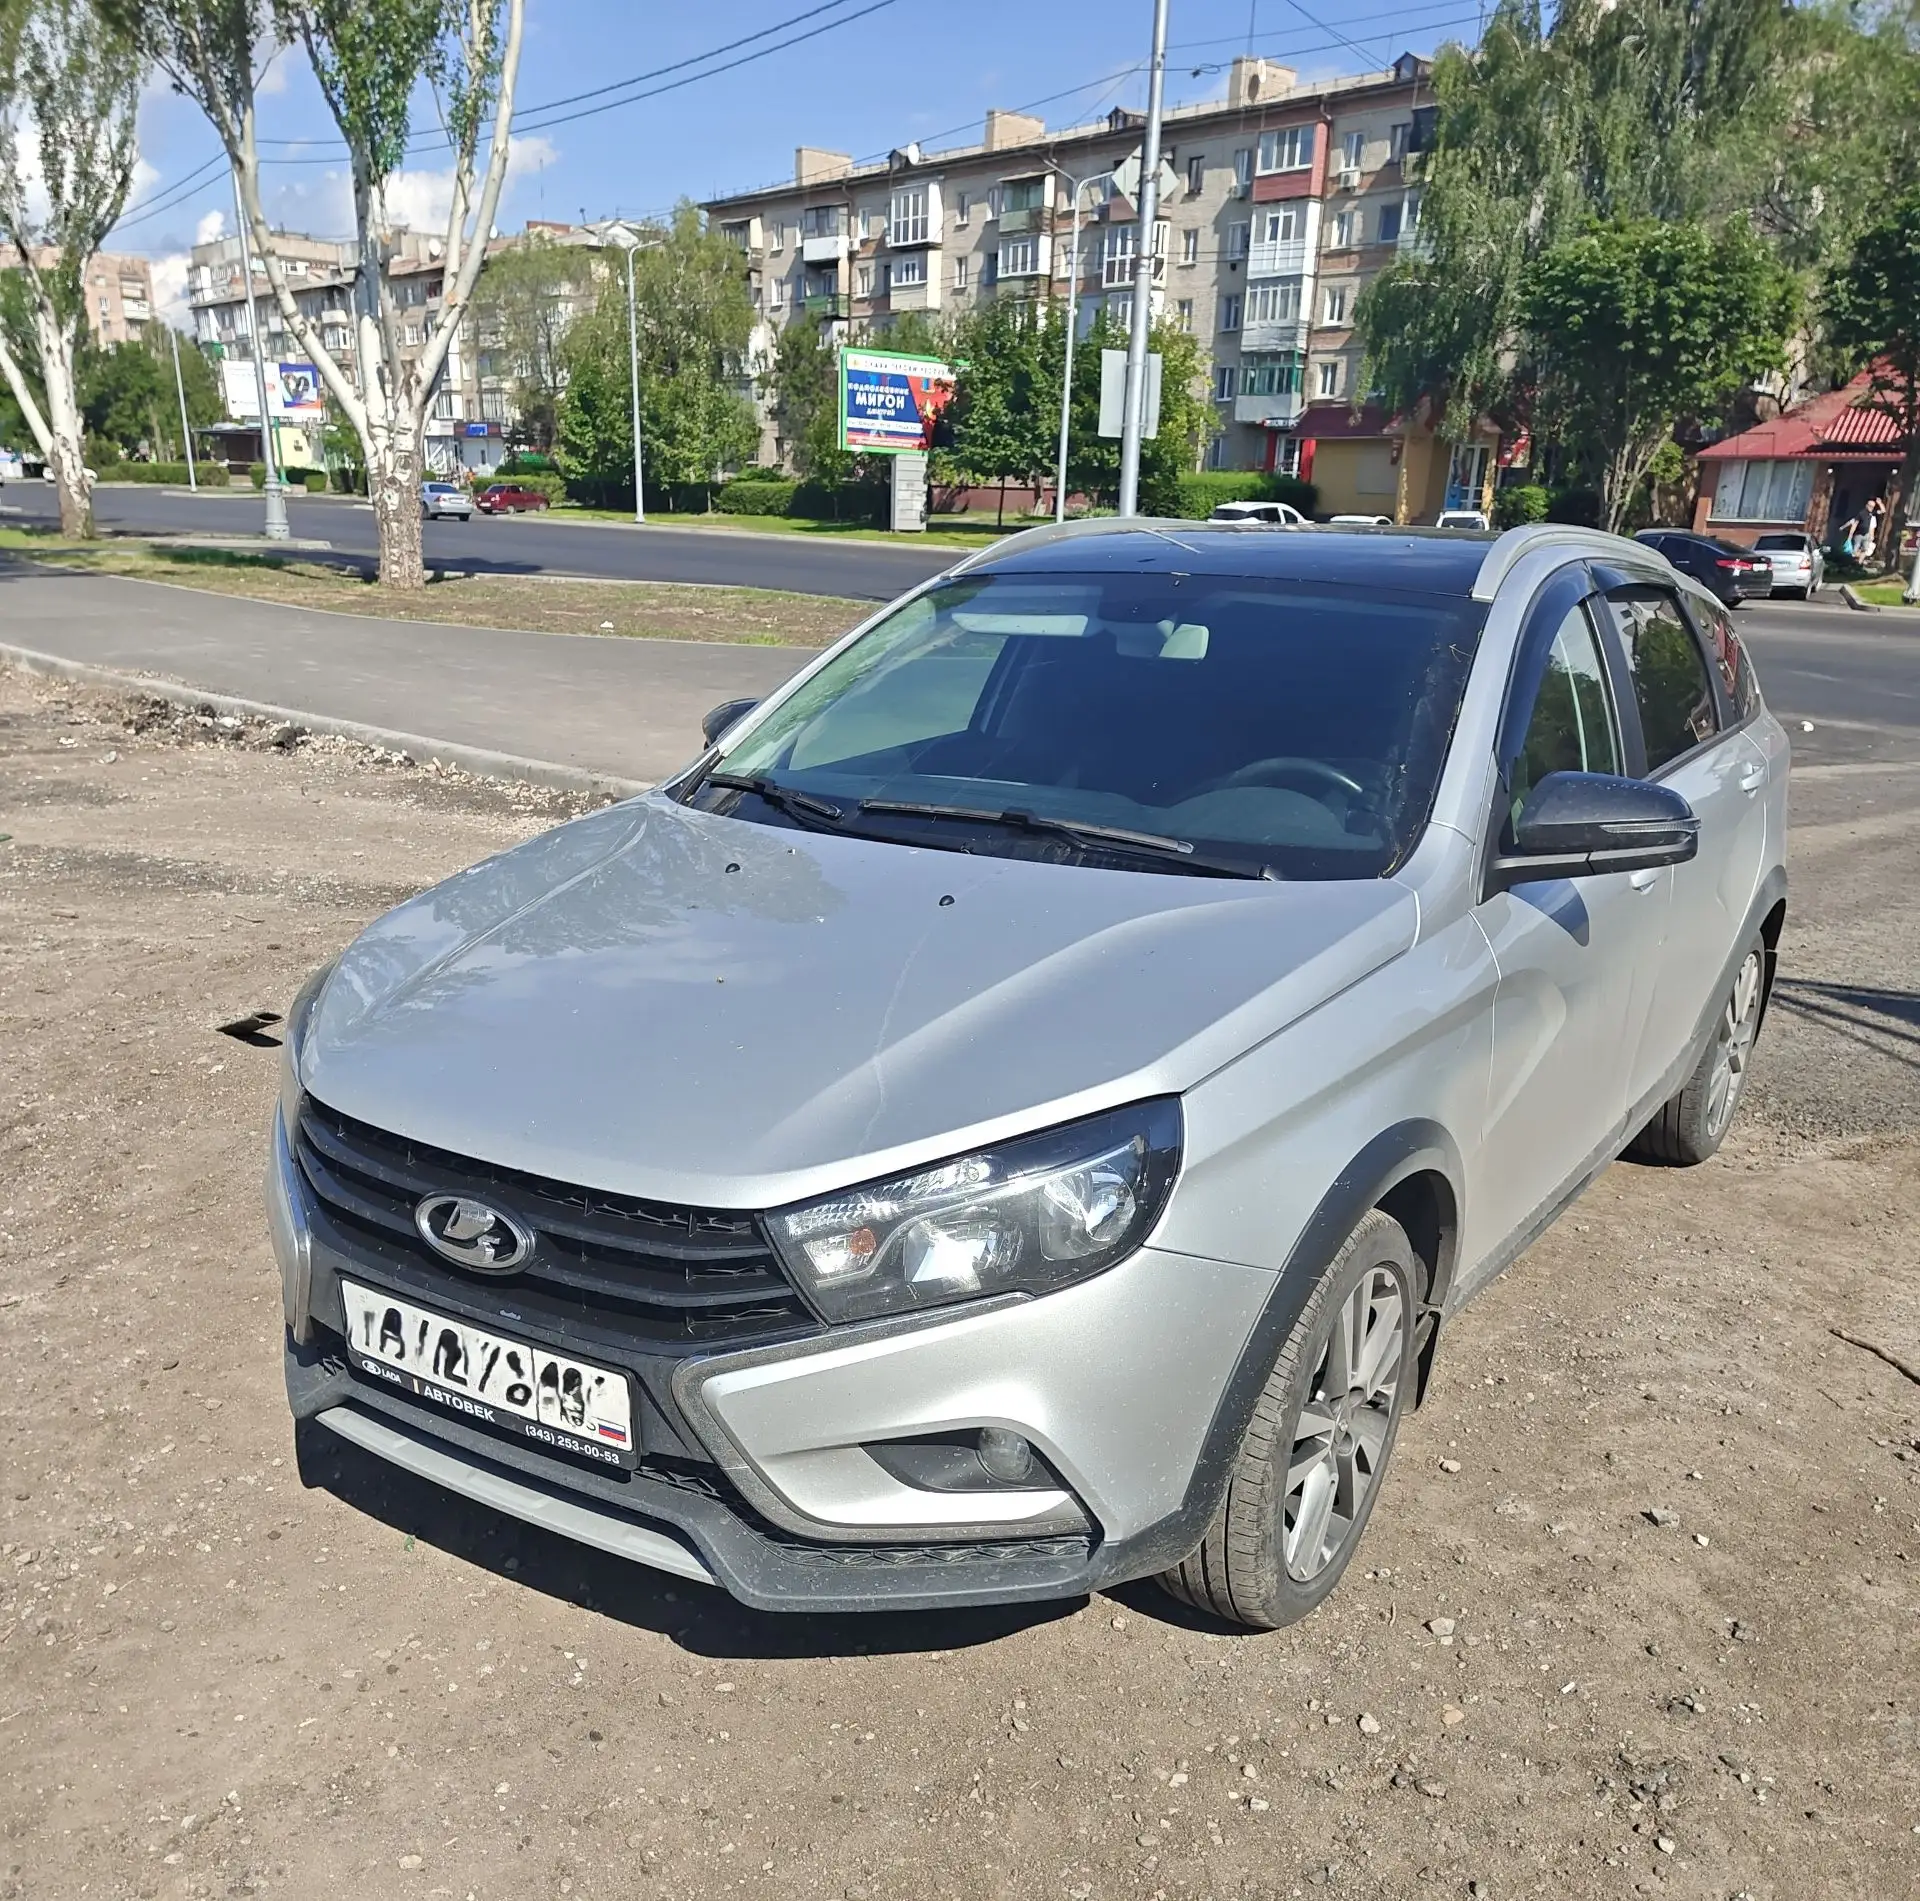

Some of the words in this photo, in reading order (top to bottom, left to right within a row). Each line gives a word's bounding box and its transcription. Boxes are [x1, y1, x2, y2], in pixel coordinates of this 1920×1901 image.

[856, 392, 905, 409] МИРОН
[381, 1368, 402, 1384] LADA
[423, 1385, 496, 1423] АВТОВЕК
[525, 1424, 555, 1445] (343)
[557, 1435, 620, 1464] 253-00-53
